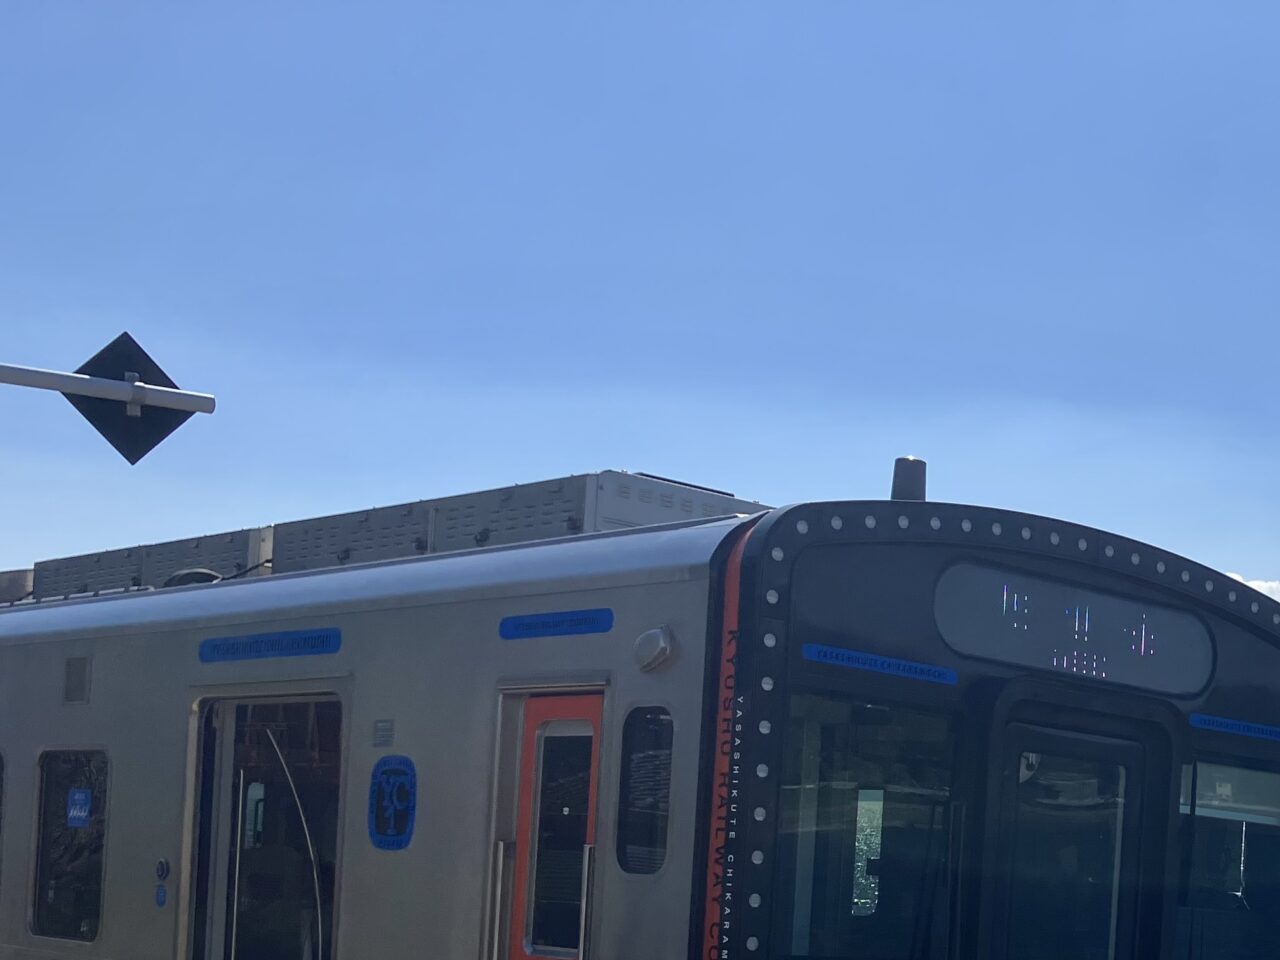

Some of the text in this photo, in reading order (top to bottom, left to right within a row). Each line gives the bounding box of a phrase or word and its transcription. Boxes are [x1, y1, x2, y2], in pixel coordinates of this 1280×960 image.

[720, 630, 738, 756] KYUSHU
[728, 695, 744, 839] YASASHIKUTE
[711, 772, 729, 904] RAILWAY
